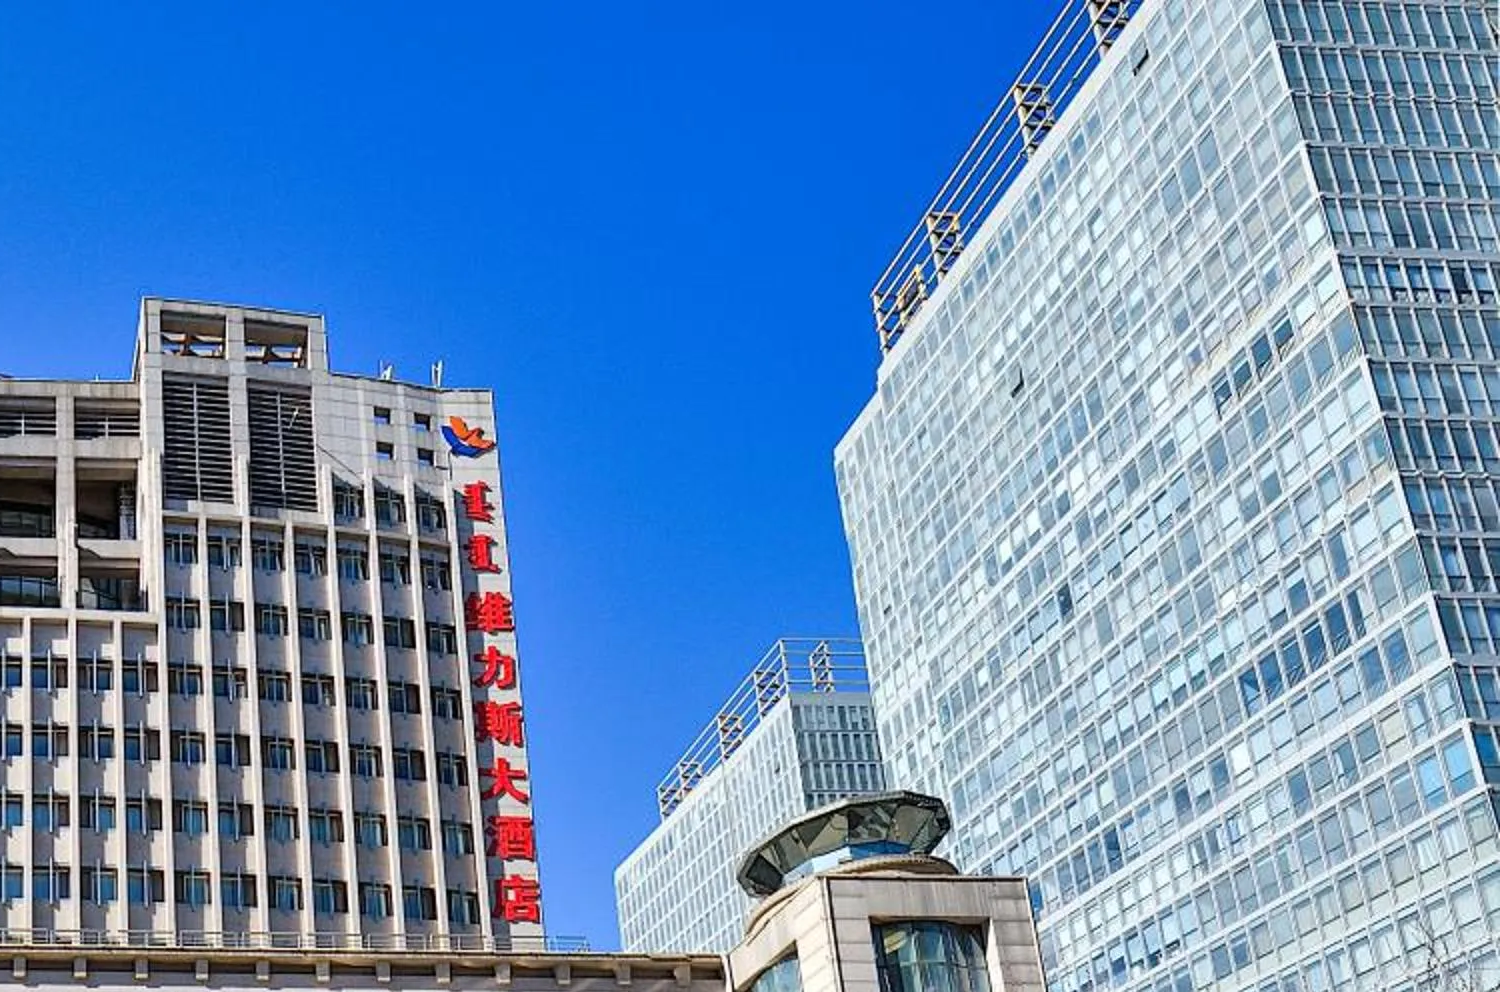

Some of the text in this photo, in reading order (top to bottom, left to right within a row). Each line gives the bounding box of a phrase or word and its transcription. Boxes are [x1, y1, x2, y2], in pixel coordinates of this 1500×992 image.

[465, 592, 540, 923] 维力斯大酒店
